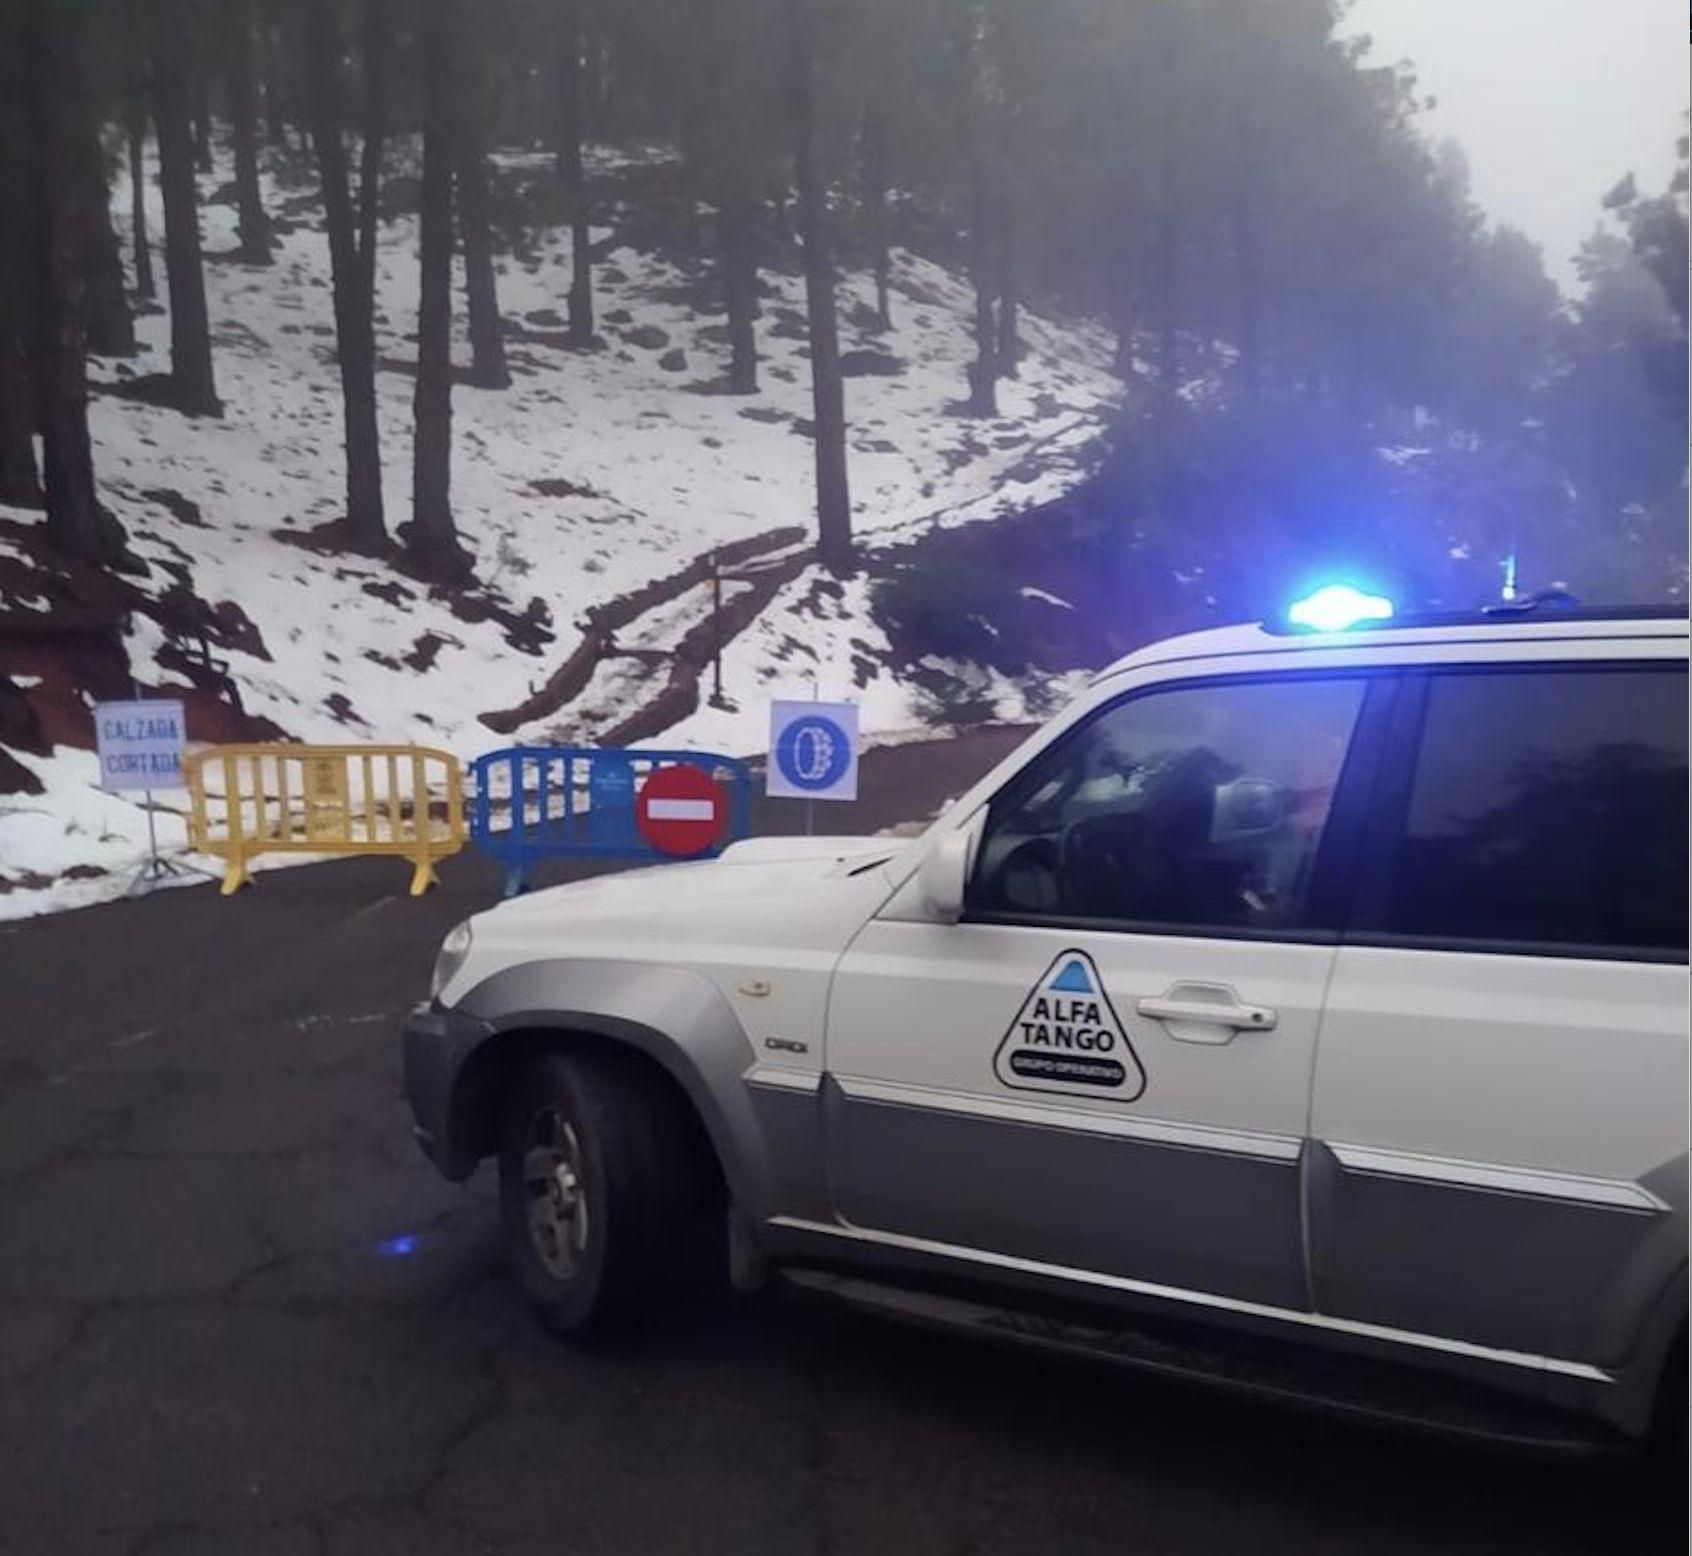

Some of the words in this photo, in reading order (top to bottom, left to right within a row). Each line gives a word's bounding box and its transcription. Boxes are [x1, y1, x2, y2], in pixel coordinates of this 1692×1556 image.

[105, 719, 178, 740] CALZADA
[106, 753, 181, 773] CORTADA
[1033, 998, 1101, 1025] ALFA
[1021, 1022, 1115, 1052] TANGO
